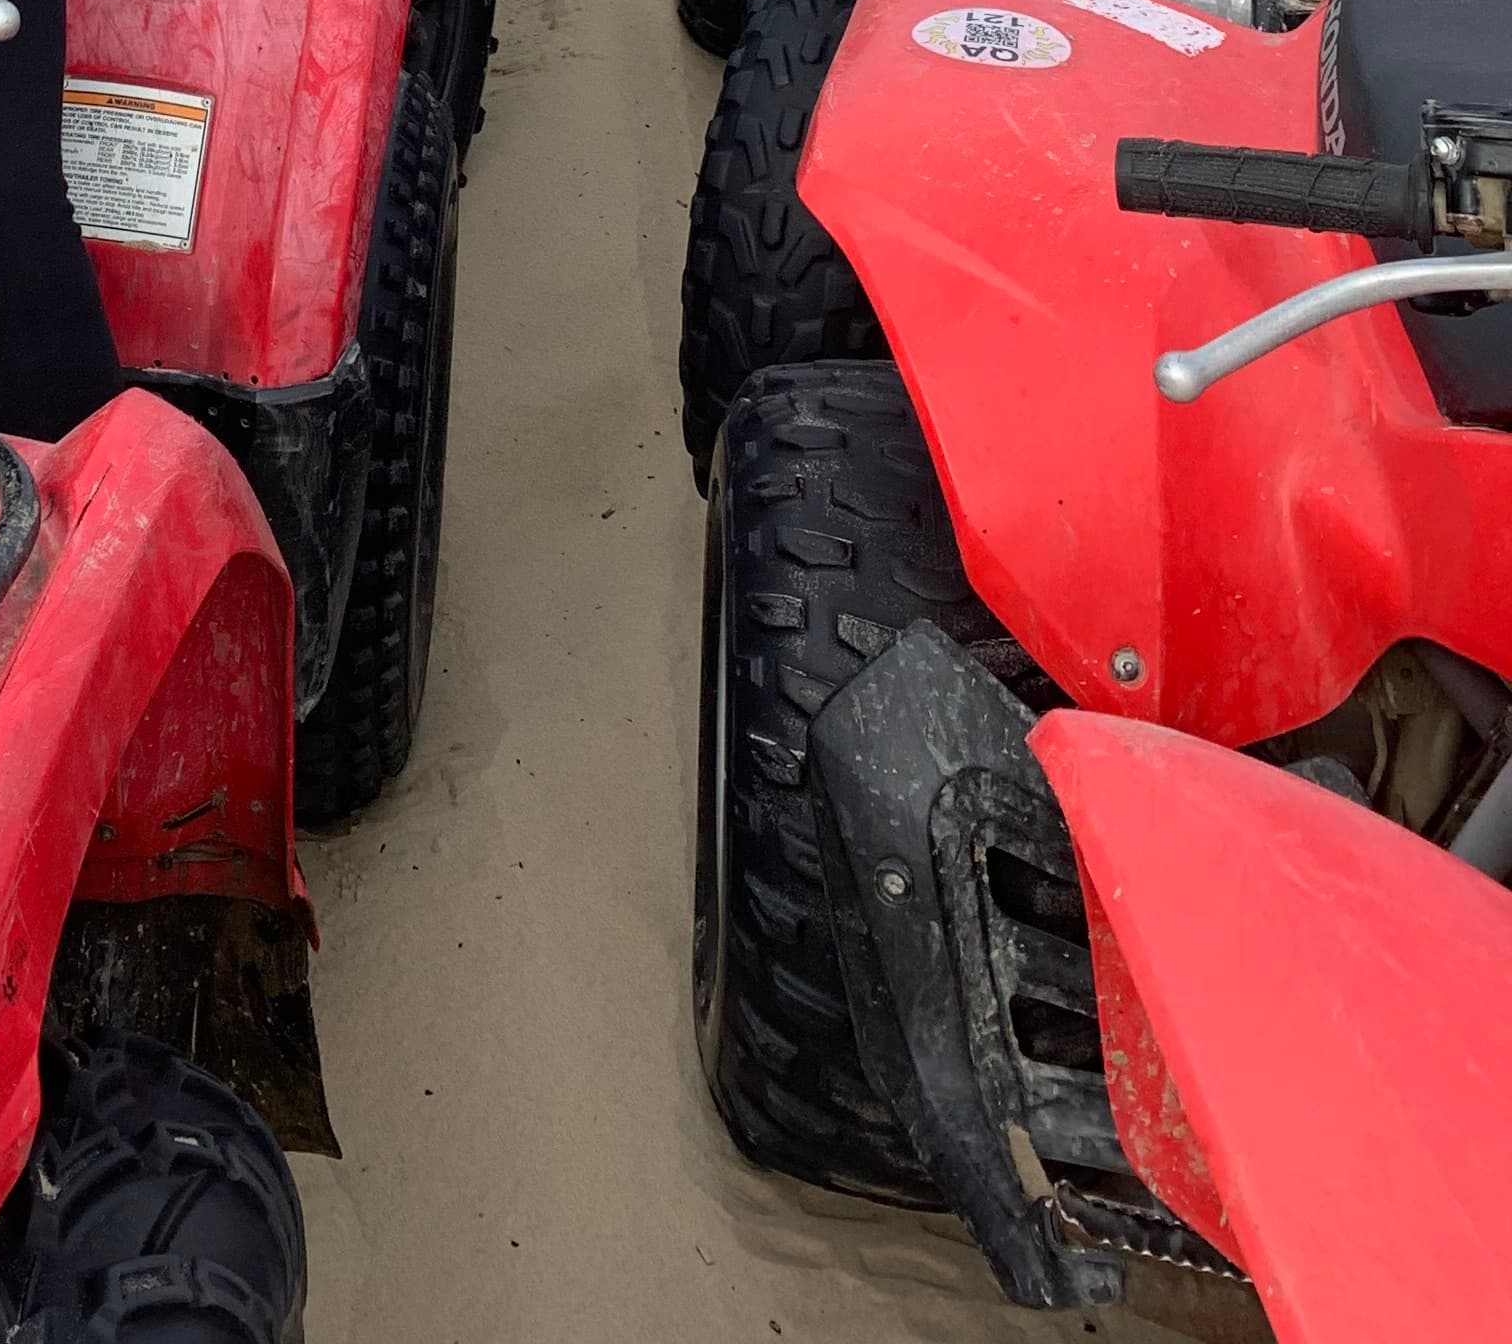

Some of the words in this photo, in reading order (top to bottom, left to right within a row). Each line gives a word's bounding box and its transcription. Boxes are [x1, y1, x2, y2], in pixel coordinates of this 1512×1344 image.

[966, 11, 1027, 29] 121
[960, 42, 1020, 64] QA
[114, 97, 156, 111] WARNING
